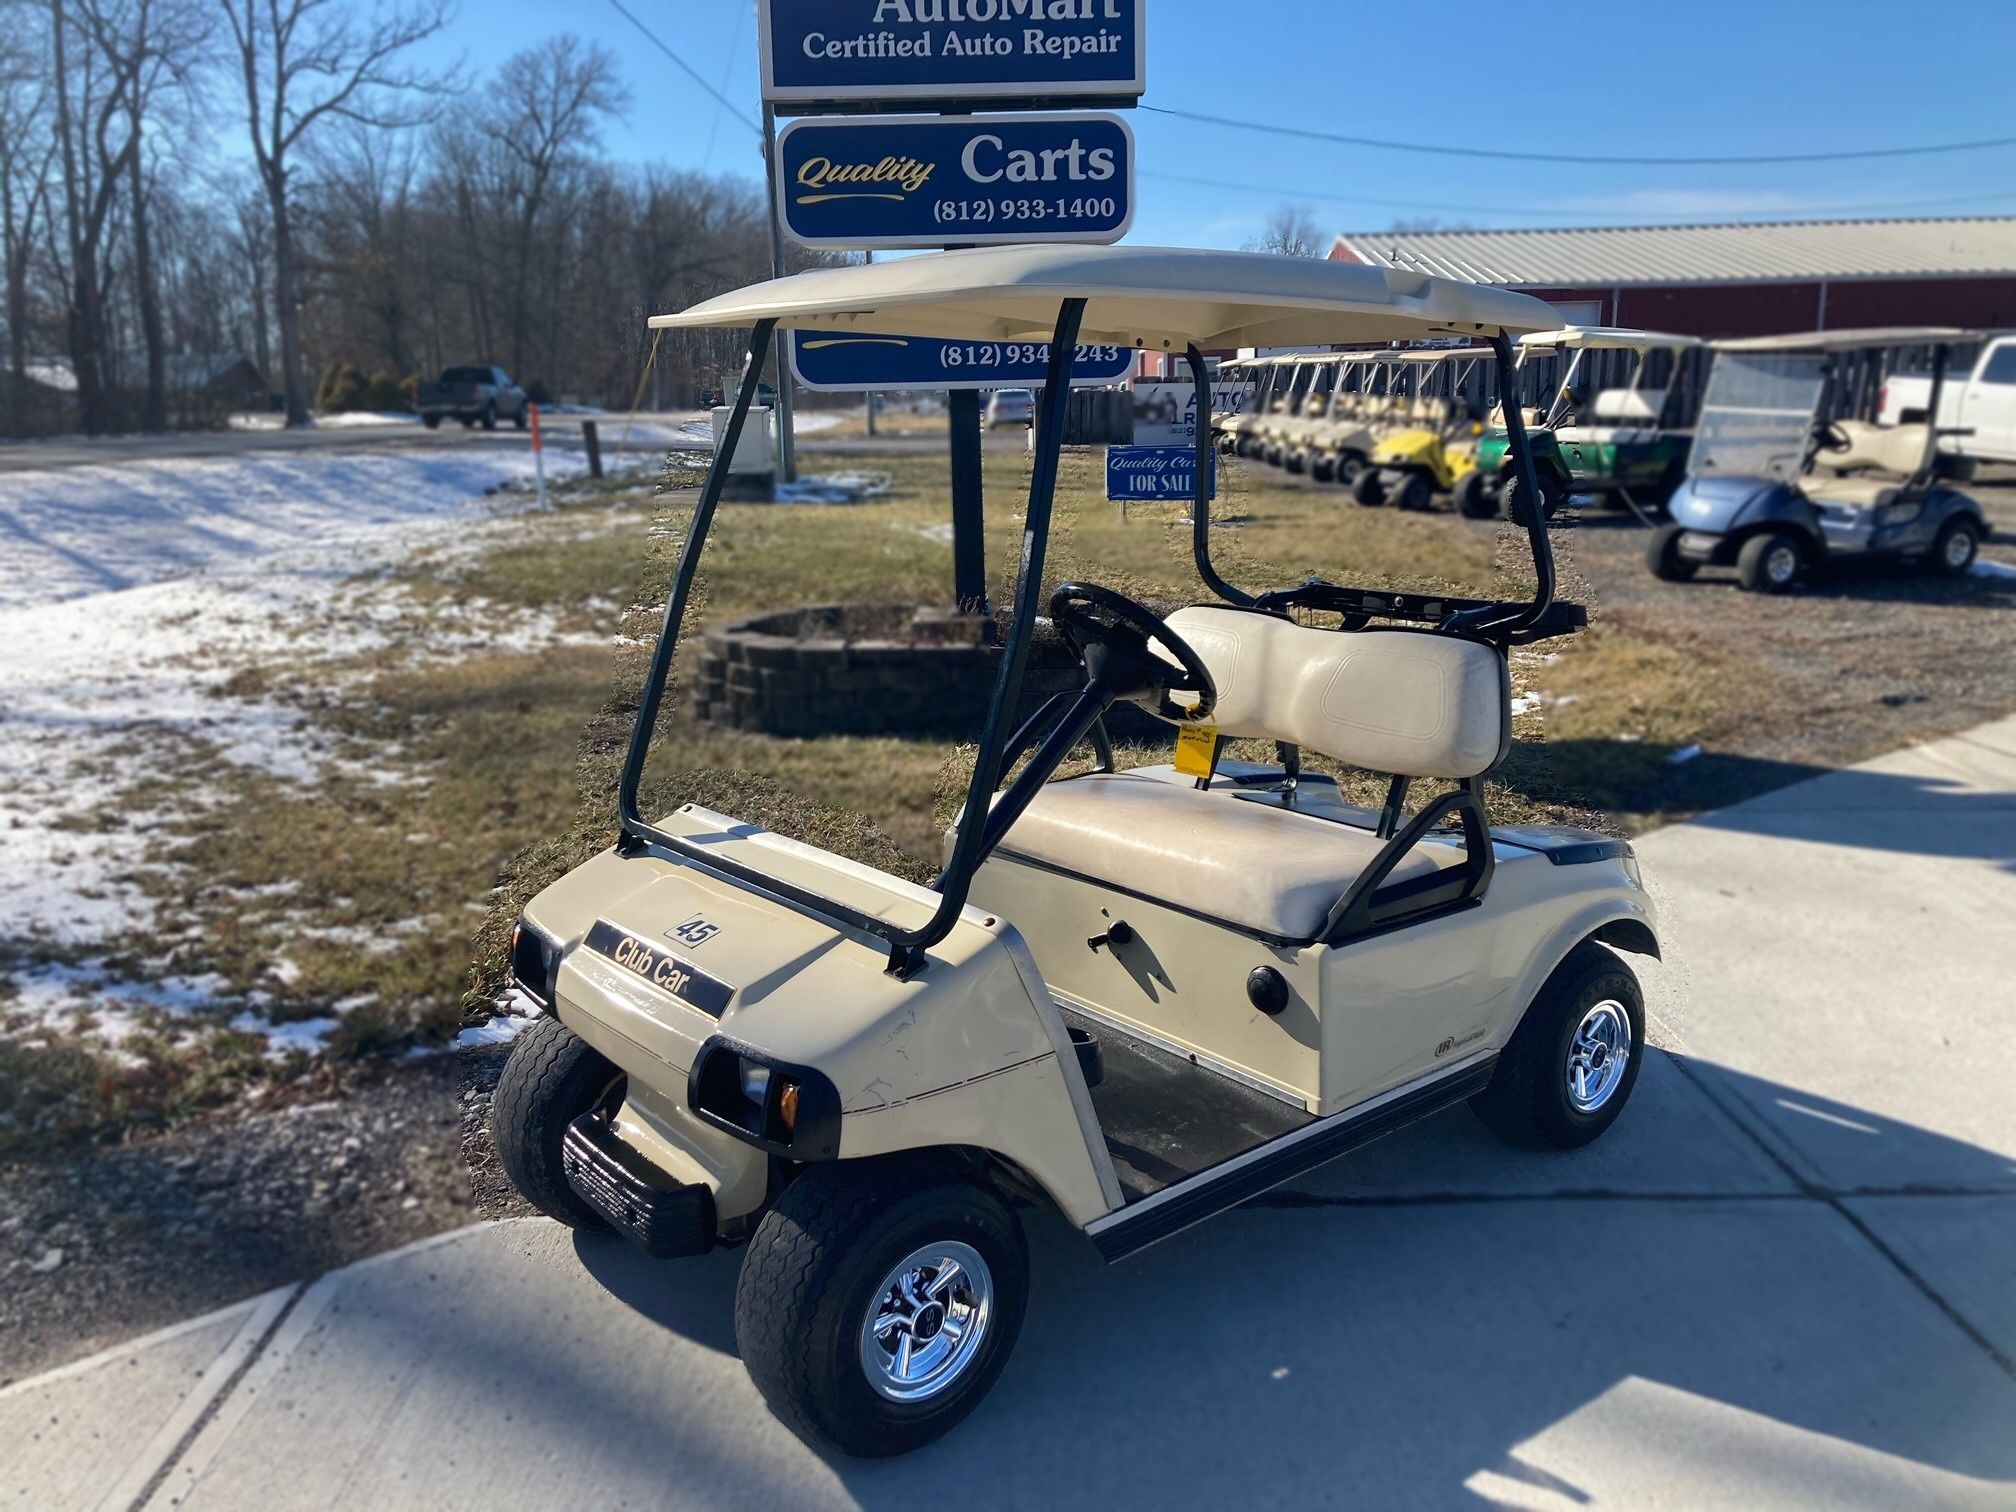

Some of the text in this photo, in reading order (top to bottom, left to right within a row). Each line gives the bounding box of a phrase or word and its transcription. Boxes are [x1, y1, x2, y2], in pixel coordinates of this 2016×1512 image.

[873, 0, 1122, 23] AutoMart
[802, 28, 1122, 59] Certified Auto Repair
[961, 134, 1115, 183] Carts
[796, 155, 936, 192] Quality
[933, 197, 1116, 224] (812) 933-1400
[940, 344, 1000, 369] (812)
[1110, 456, 1168, 473] Quality
[1129, 474, 1192, 492] FOR SALE
[675, 919, 719, 943] 45
[614, 937, 691, 993] Club Car
